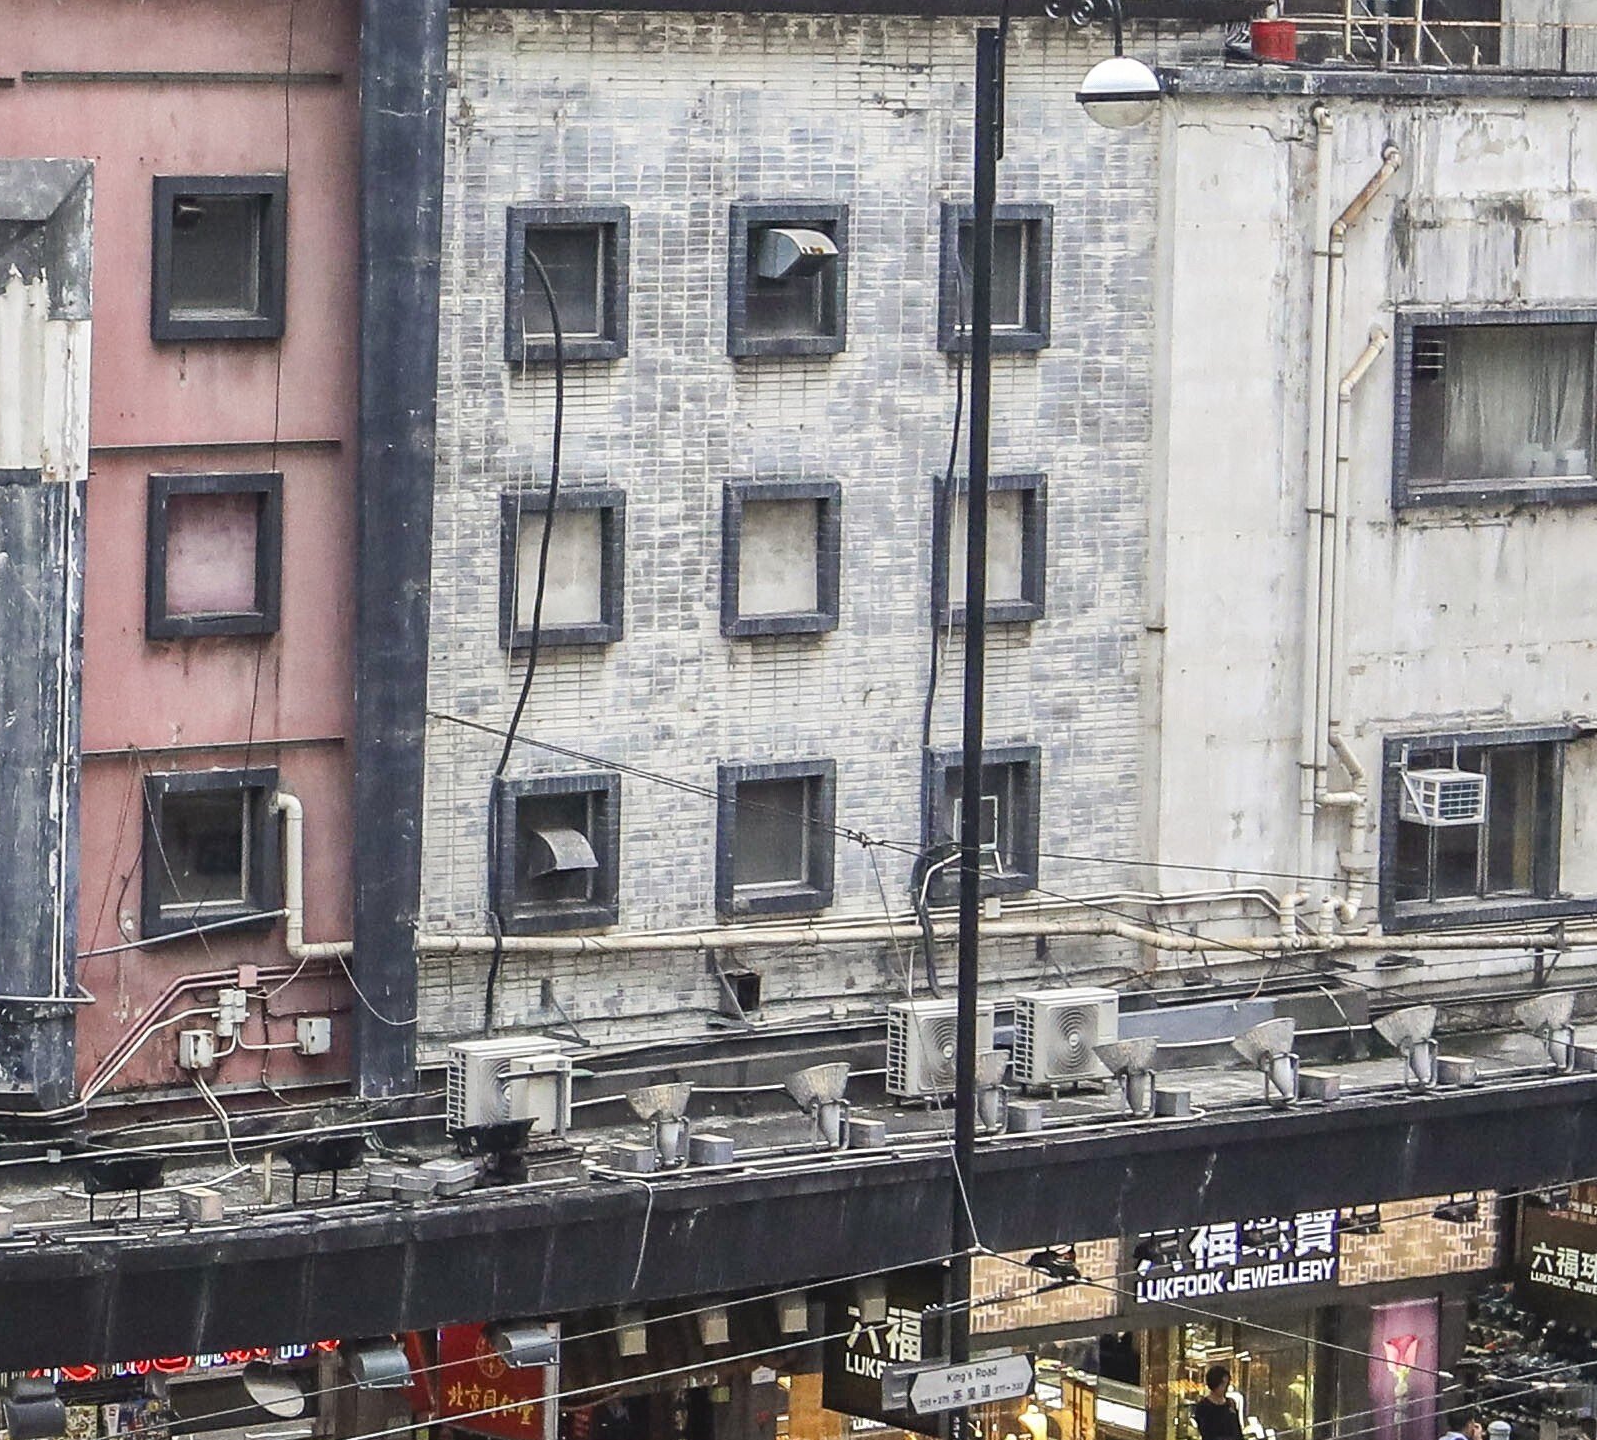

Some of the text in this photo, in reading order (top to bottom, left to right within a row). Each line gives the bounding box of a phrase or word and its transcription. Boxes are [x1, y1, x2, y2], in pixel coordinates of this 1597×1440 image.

[1136, 1258, 1336, 1304] LUKFOOK JEWELLERY
[1530, 1271, 1571, 1290] LUKFOOK
[947, 1365, 998, 1385] King's Road
[953, 1384, 992, 1402] 英皇道
[447, 1381, 535, 1426] 北京同仁堂
